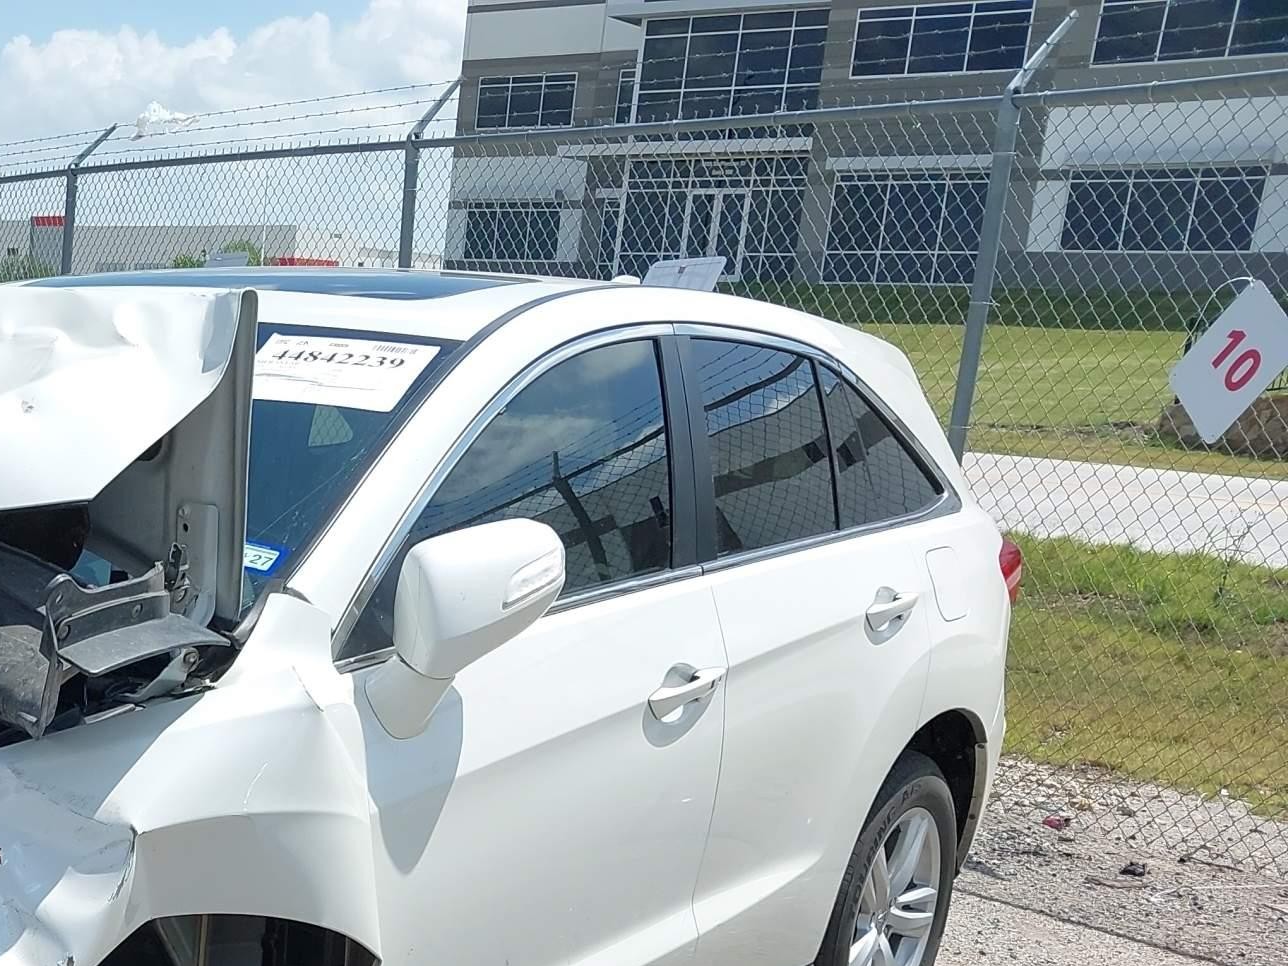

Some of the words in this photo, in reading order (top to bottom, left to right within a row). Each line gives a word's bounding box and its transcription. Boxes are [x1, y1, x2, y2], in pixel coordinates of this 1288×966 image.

[271, 348, 406, 370] 44842239
[1211, 329, 1262, 392] 10
[248, 553, 274, 567] 27
